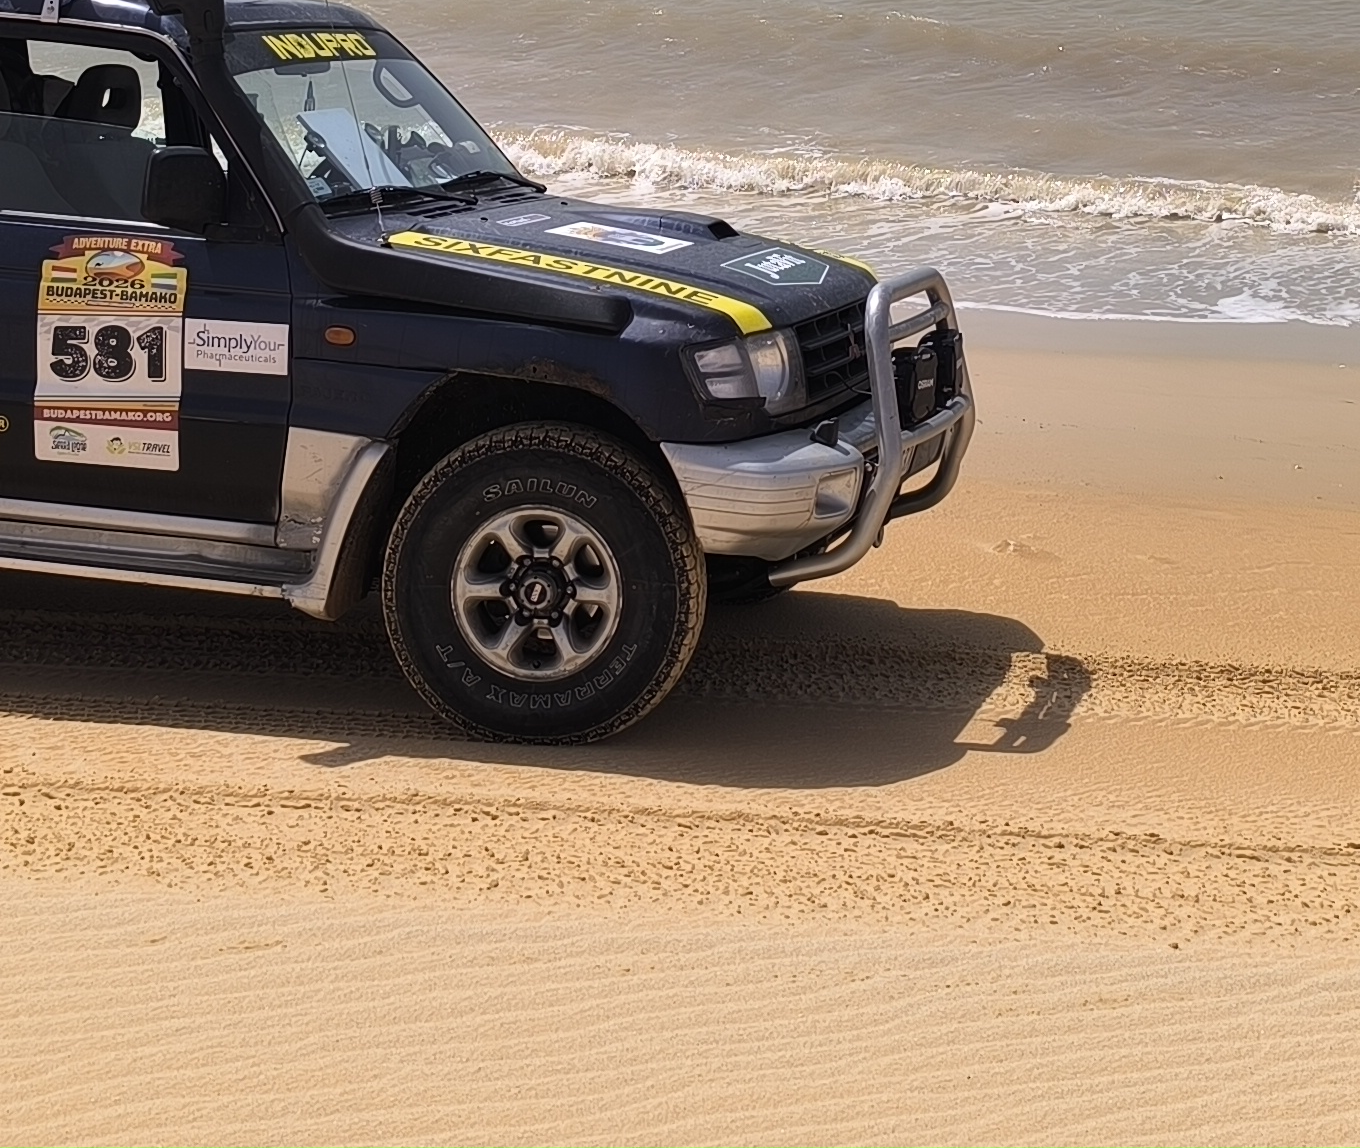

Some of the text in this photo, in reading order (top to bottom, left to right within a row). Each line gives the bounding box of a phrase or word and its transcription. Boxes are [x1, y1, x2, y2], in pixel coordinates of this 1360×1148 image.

[261, 33, 377, 59] INDUPRO
[72, 237, 162, 254] ADVENTURE EXTRA
[82, 275, 145, 290] 2026
[414, 236, 719, 306] SIXFASTNINE
[46, 285, 178, 305] BUDAPEST-BAMAKO
[50, 323, 168, 382] 581
[196, 350, 277, 365] Pharmaceuticals
[43, 408, 172, 422] BUDAPESTBAMAKO.ORG
[483, 477, 597, 509] SAILUN
[435, 642, 638, 709] TERRAMAX A/T
